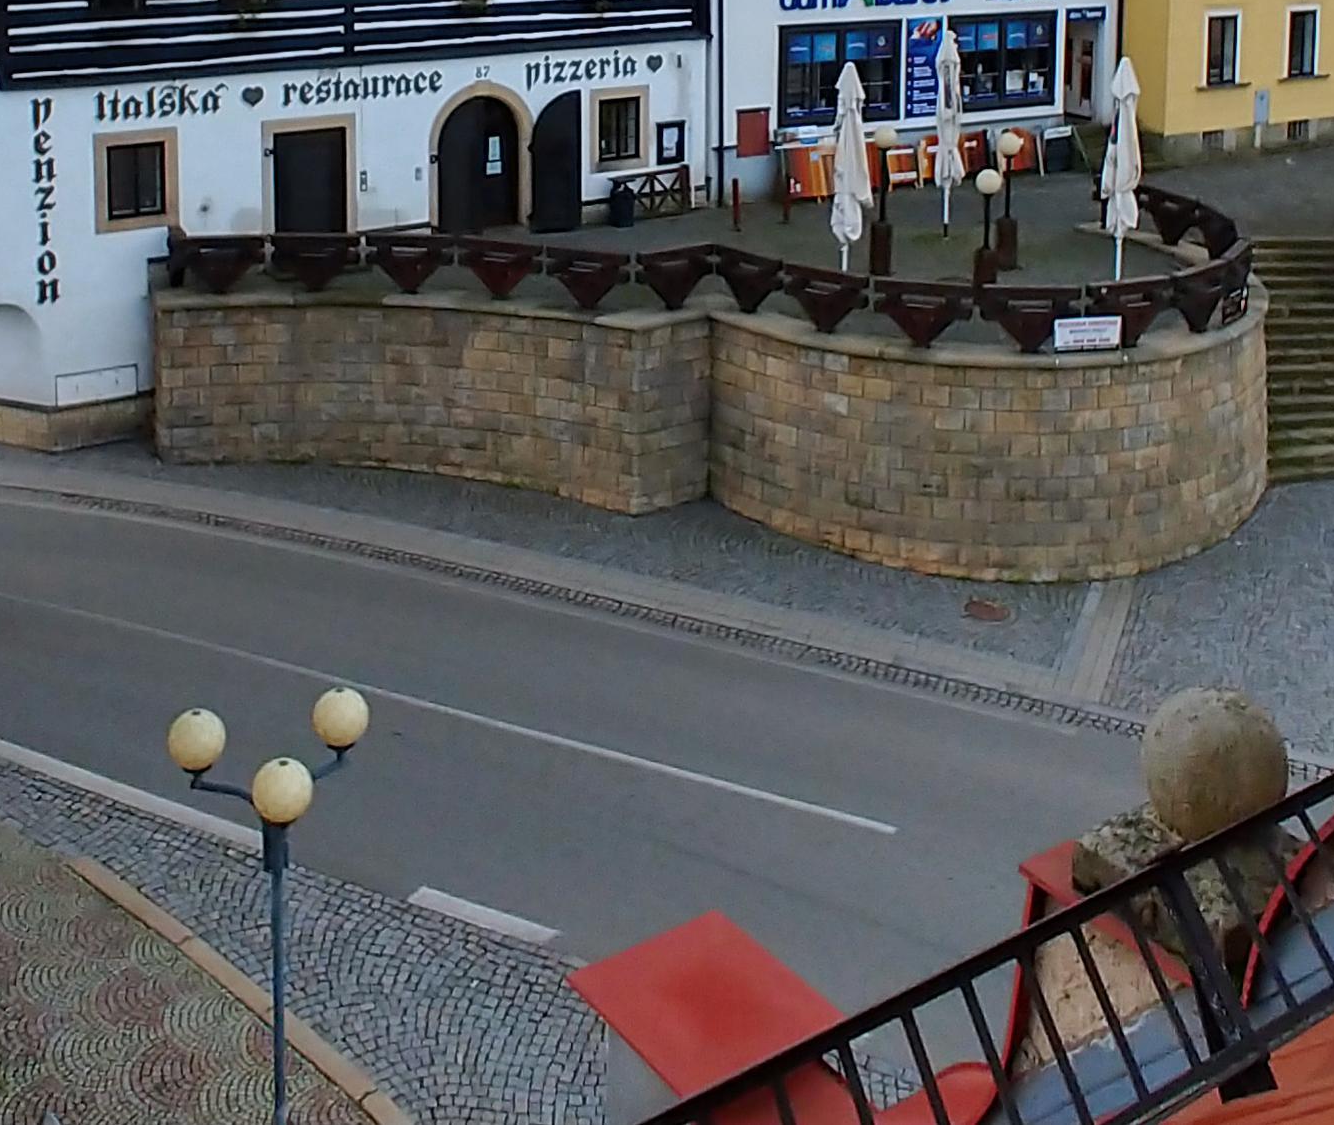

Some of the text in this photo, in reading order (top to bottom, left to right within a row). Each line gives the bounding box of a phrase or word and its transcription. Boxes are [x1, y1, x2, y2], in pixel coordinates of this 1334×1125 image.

[282, 69, 443, 107] restaurace
[525, 49, 637, 91] pizzeria
[475, 65, 490, 79] 87
[31, 97, 60, 304] penzion
